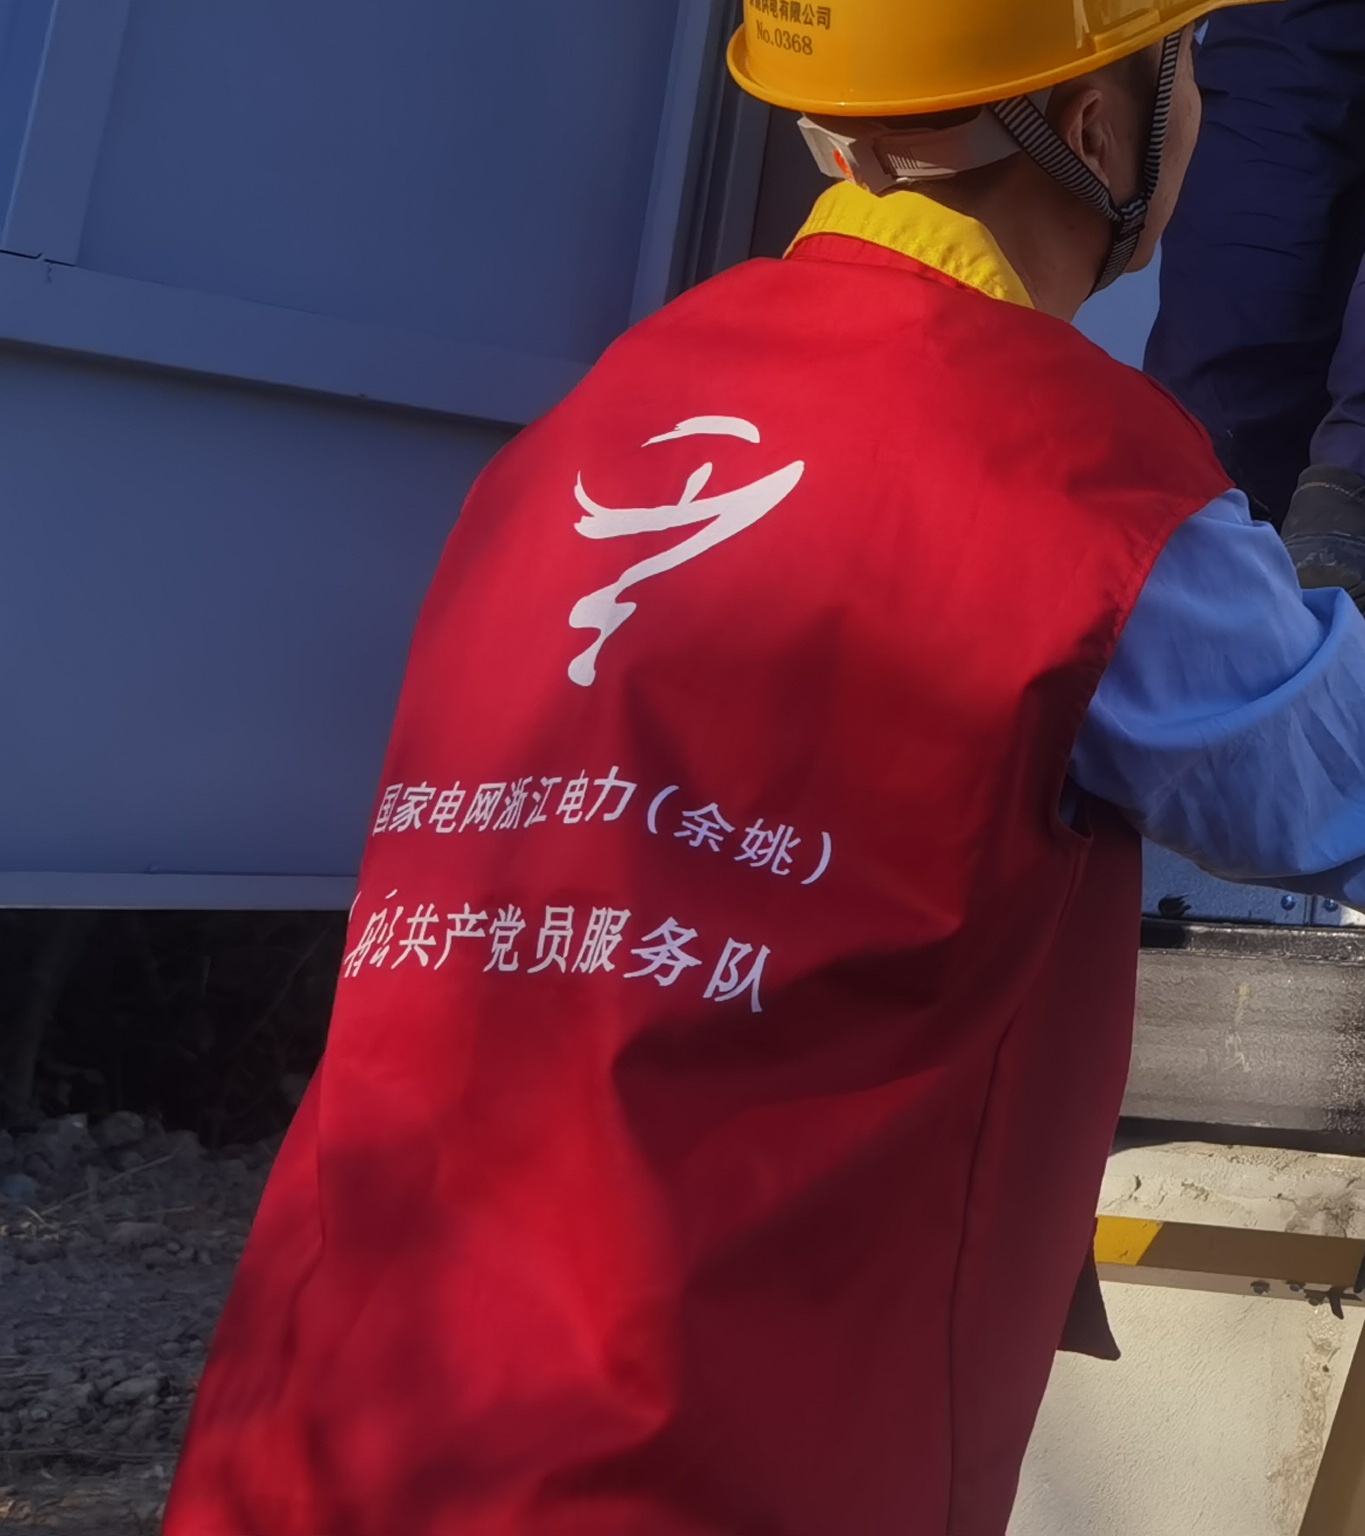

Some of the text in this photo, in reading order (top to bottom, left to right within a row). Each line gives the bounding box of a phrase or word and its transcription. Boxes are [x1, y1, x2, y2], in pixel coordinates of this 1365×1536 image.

[756, 20, 813, 56] No.0368
[344, 888, 771, 1013] 船共产党员服务队
